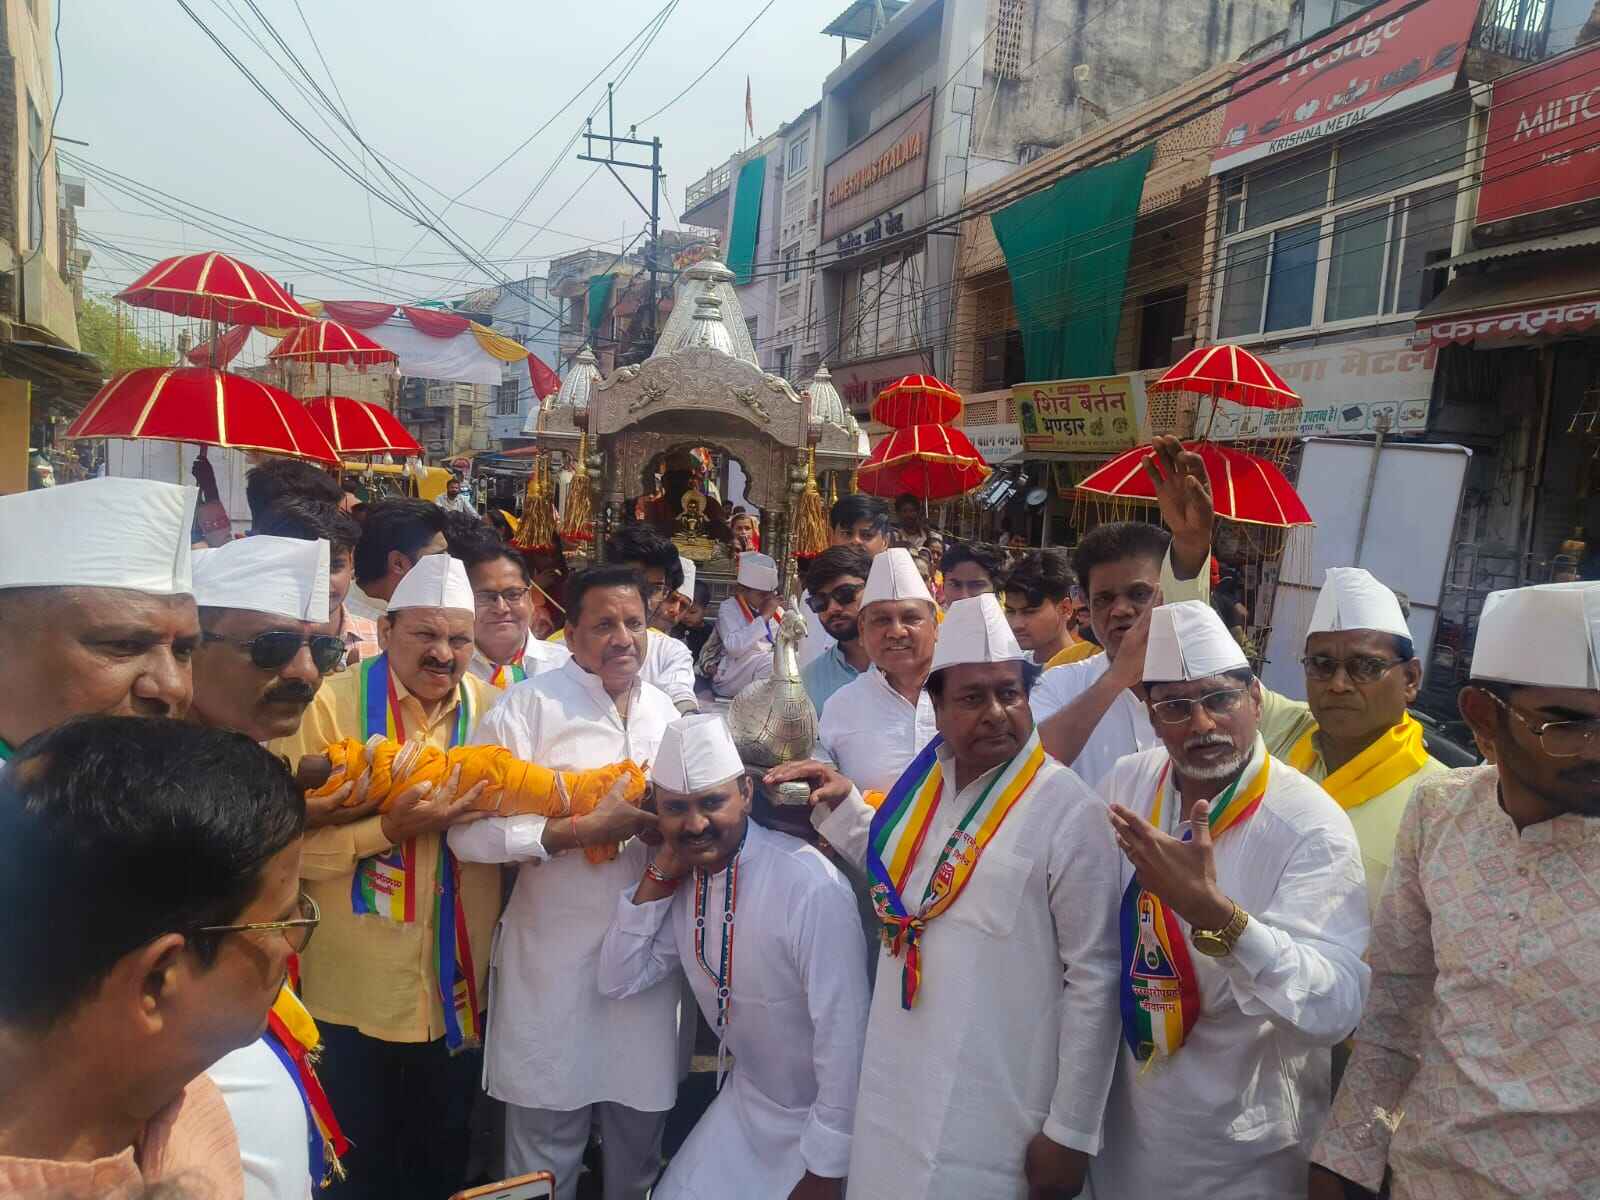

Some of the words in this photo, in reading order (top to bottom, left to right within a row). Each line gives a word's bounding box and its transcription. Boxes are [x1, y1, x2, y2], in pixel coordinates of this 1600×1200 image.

[1268, 128, 1322, 154] KRISHNA
[1326, 107, 1368, 137] METAL
[1033, 389, 1073, 415] शिव
[1078, 384, 1127, 413] बर्तन
[1042, 417, 1088, 436] भण्डार
